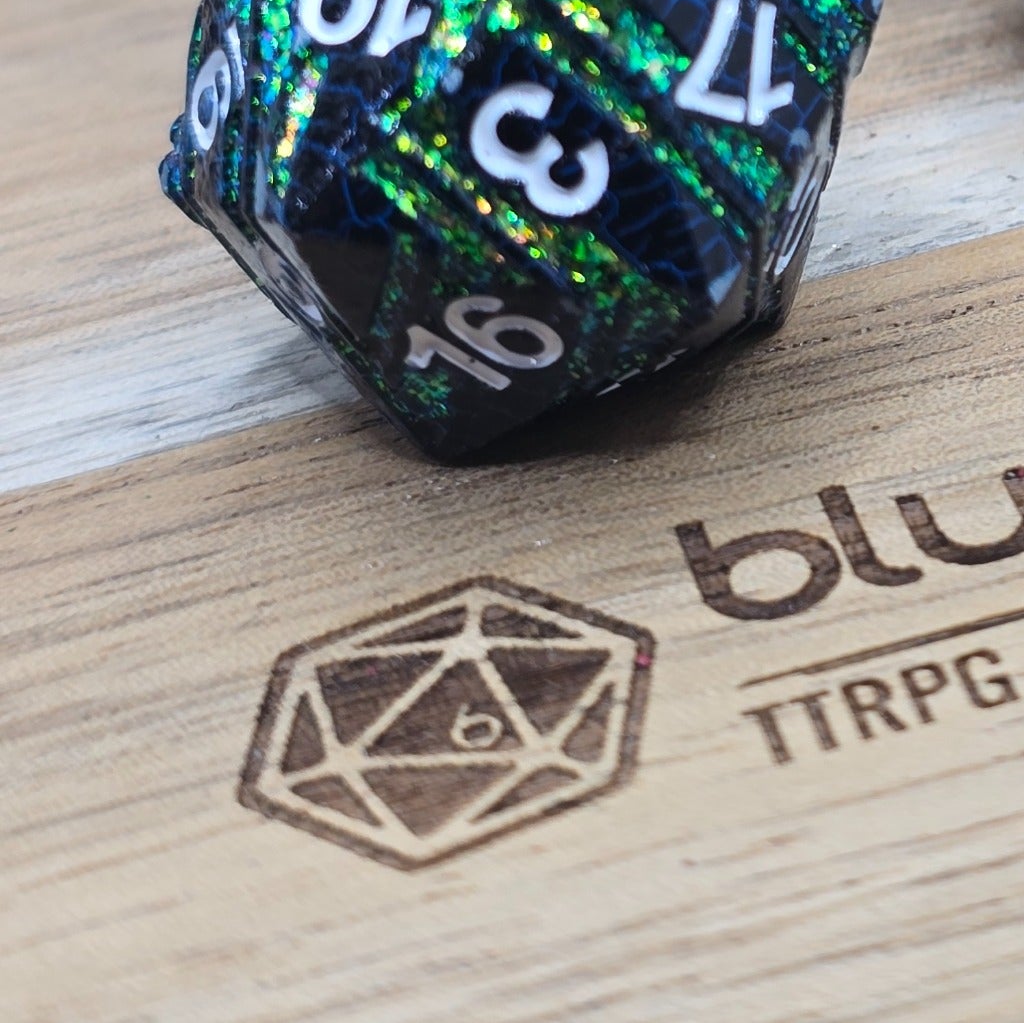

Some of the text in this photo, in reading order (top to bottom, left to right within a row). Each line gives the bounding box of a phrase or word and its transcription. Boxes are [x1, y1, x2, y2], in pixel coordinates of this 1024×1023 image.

[469, 82, 611, 218] 3
[404, 295, 565, 392] 16
[743, 647, 1020, 766] TTRPG
